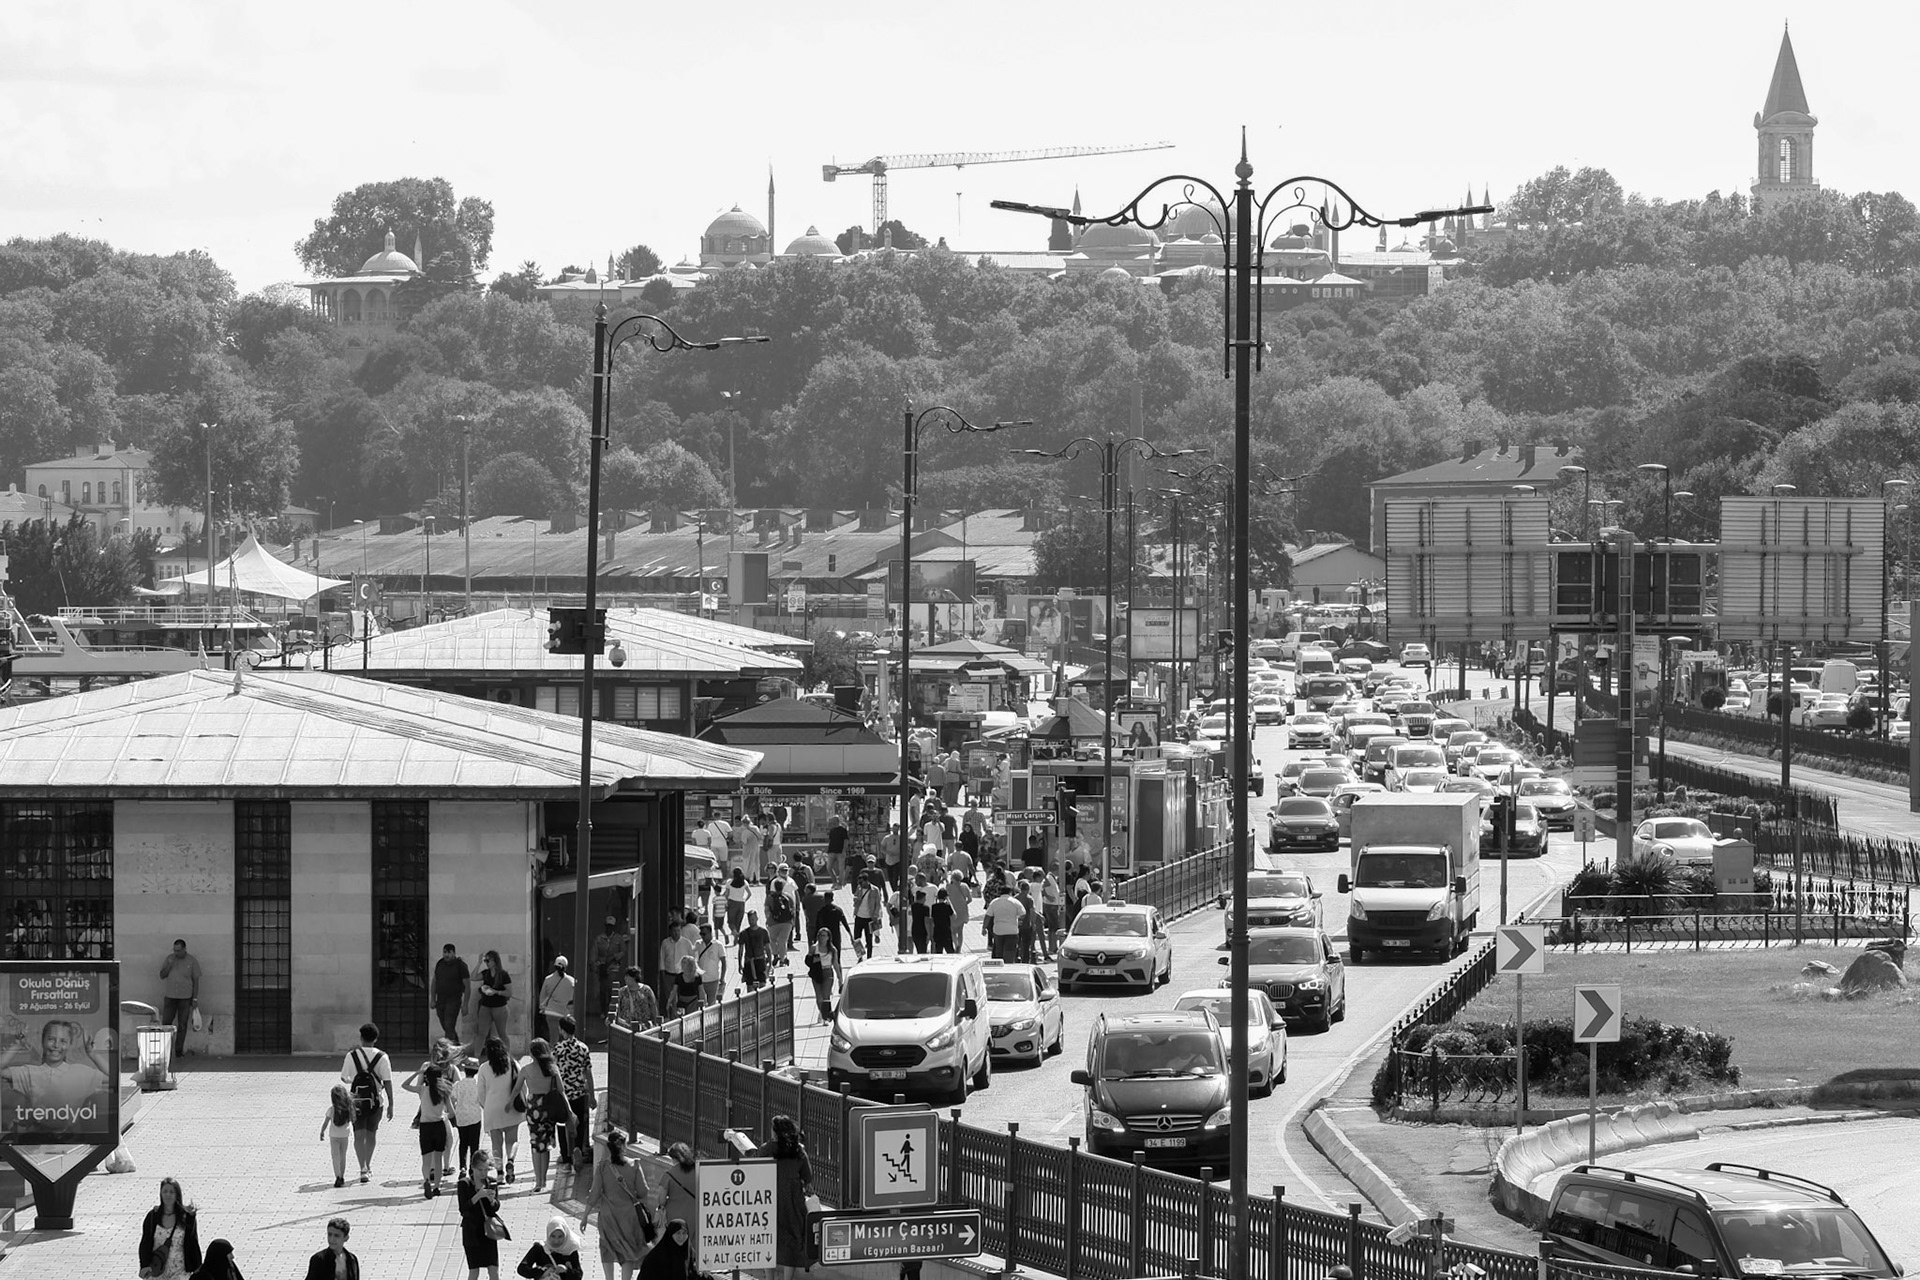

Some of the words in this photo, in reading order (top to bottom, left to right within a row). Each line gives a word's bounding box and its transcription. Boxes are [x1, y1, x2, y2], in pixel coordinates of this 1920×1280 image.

[754, 786, 772, 794] Büfe
[820, 786, 842, 794] Since
[19, 978, 52, 988] Okula
[55, 977, 90, 990] Dönüş
[31, 989, 78, 1000] Fırsatları
[30, 1003, 57, 1011] Ağustos
[74, 1002, 90, 1011] Eylül
[16, 1104, 96, 1124] trendyol
[1148, 1139, 1157, 1147] 34
[1169, 1138, 1185, 1146] 1199
[703, 1188, 772, 1206] BAĞCILAR
[706, 1211, 769, 1230] KABATAŞ
[854, 1224, 893, 1240] Mısır
[899, 1222, 953, 1241] Çarşısı
[703, 1234, 746, 1246] TRAMWAY
[750, 1233, 773, 1244] HATTI
[714, 1253, 730, 1263] ALT
[734, 1250, 761, 1264] GEÇİT
[863, 1246, 908, 1258] (Egyptian
[910, 1243, 944, 1253] Bazaar)
